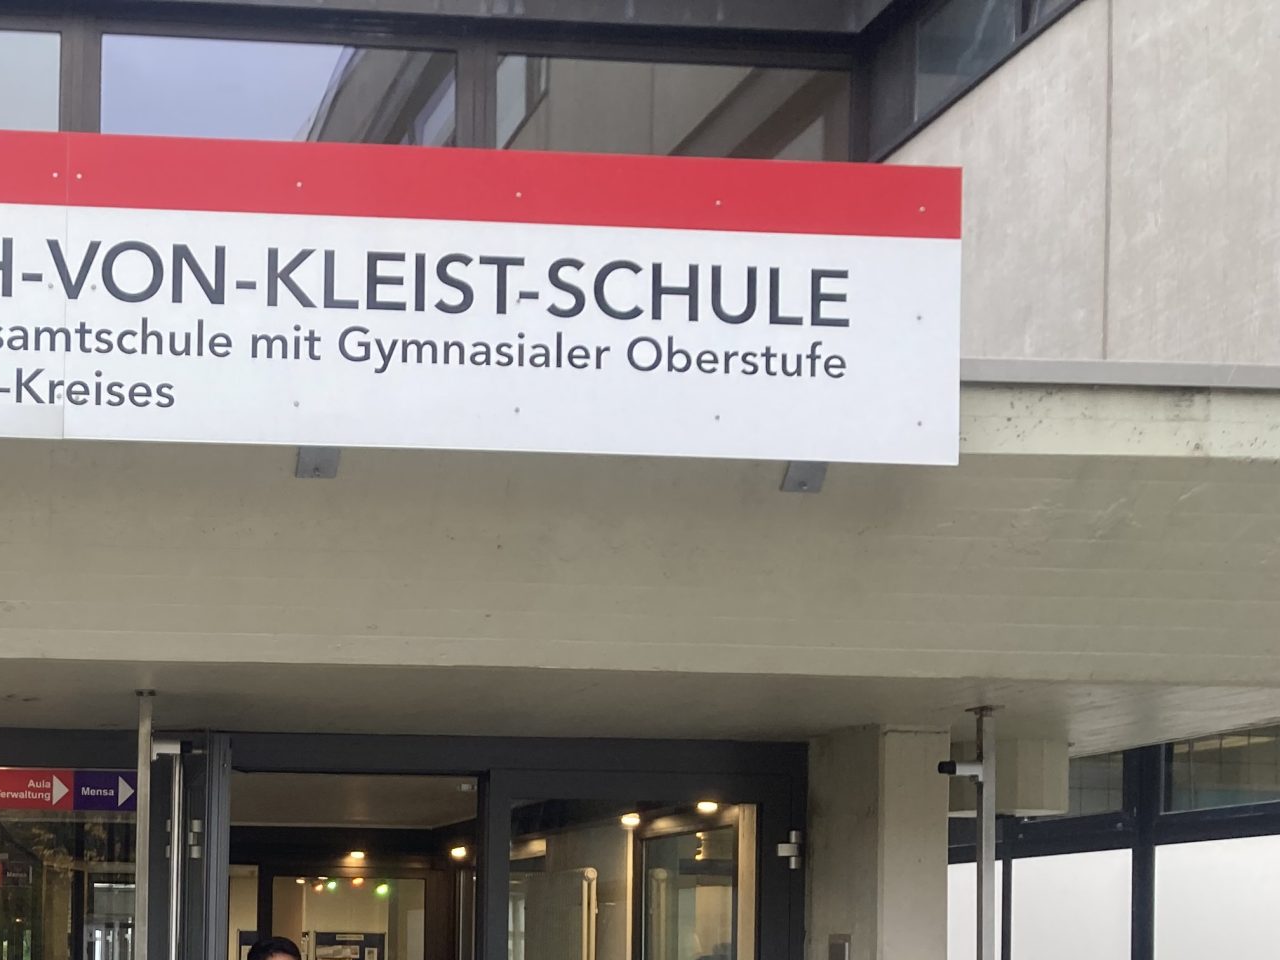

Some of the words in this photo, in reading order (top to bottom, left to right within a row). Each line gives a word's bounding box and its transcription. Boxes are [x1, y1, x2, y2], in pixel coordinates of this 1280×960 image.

[250, 325, 322, 361] mit
[338, 325, 612, 374] Gymnasialer
[626, 335, 848, 380] Oberstufe
[28, 779, 51, 788] Aula
[81, 787, 114, 796] Mensa
